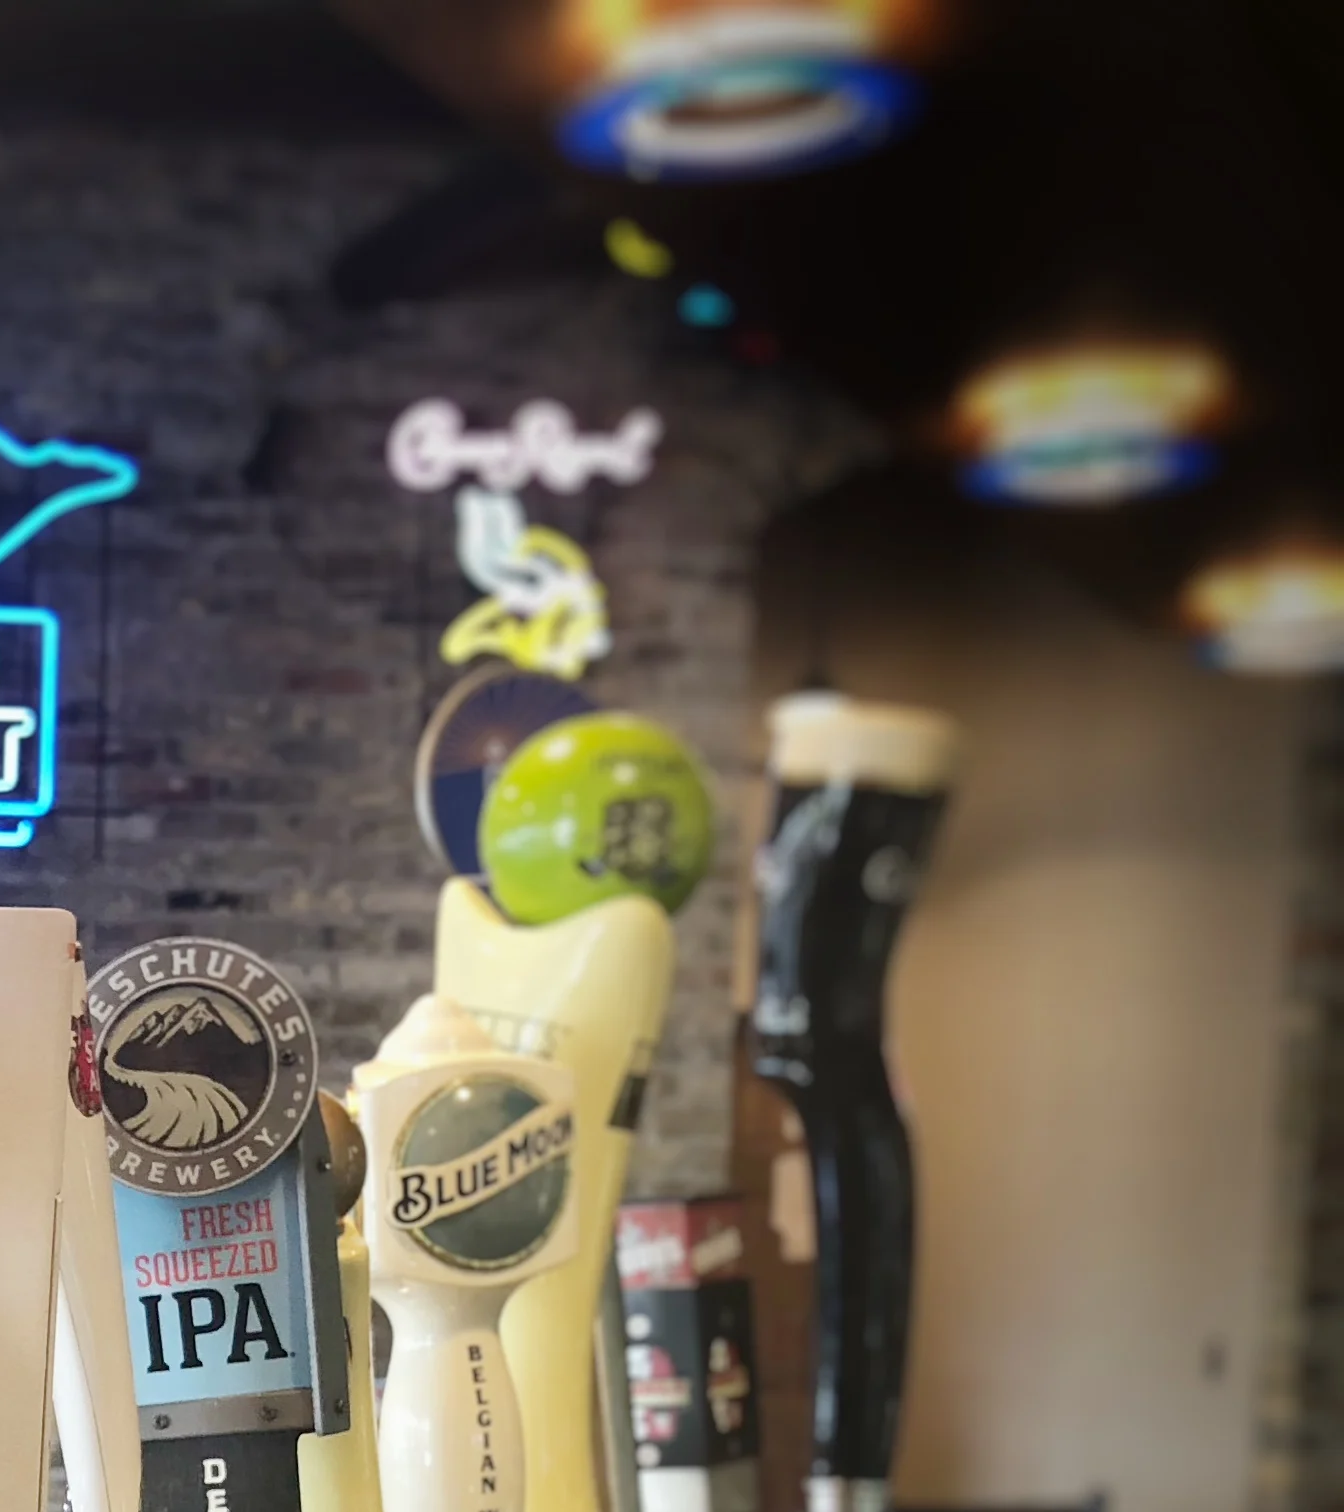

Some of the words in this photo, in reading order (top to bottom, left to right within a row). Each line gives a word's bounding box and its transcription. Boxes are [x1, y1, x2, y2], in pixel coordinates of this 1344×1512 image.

[88, 947, 306, 1042] ESCHUTES
[134, 1239, 279, 1288] SQUEEZED
[180, 1198, 274, 1241] FRESH
[139, 1282, 288, 1374] IPA
[467, 1344, 497, 1494] BELGIAN
